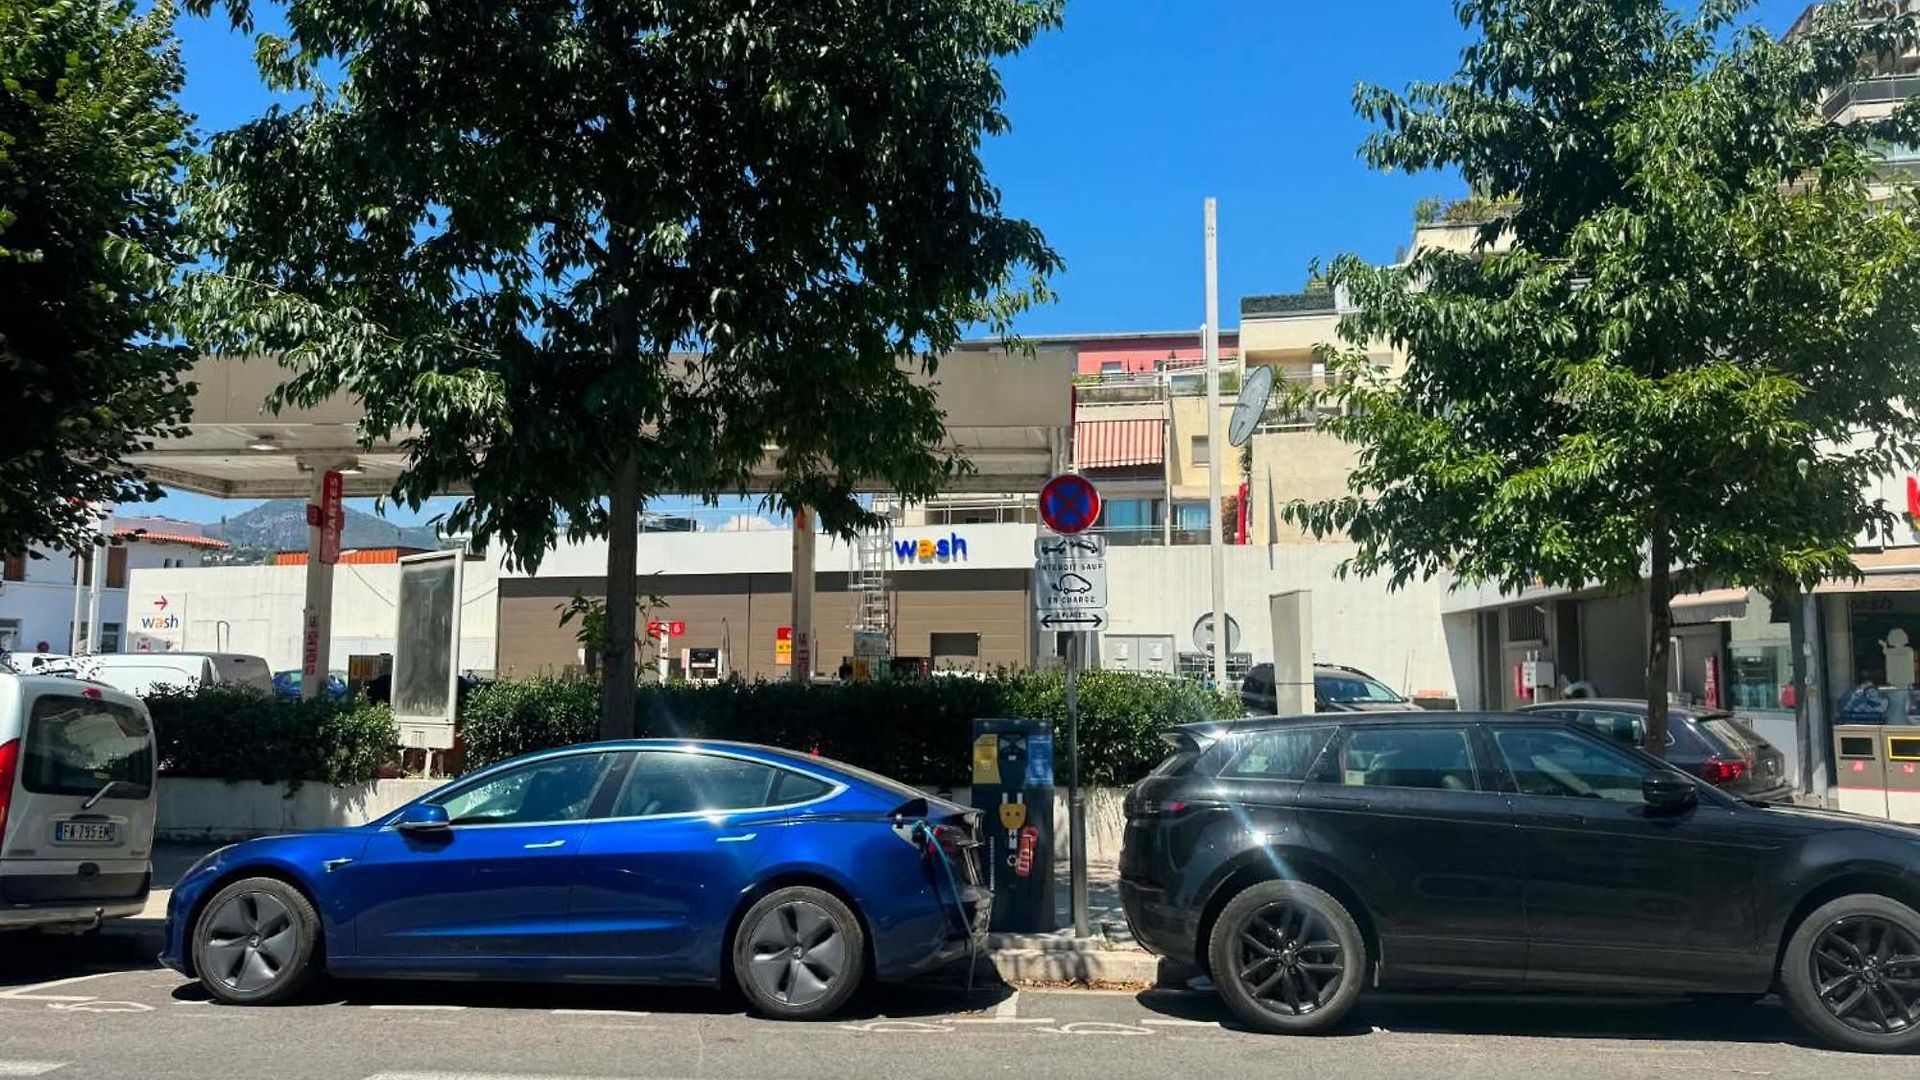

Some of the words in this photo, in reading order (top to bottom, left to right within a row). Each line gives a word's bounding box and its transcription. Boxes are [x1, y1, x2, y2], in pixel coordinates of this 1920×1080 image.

[895, 532, 967, 561] wash
[1081, 563, 1103, 571] SAUF
[141, 614, 179, 629] wash
